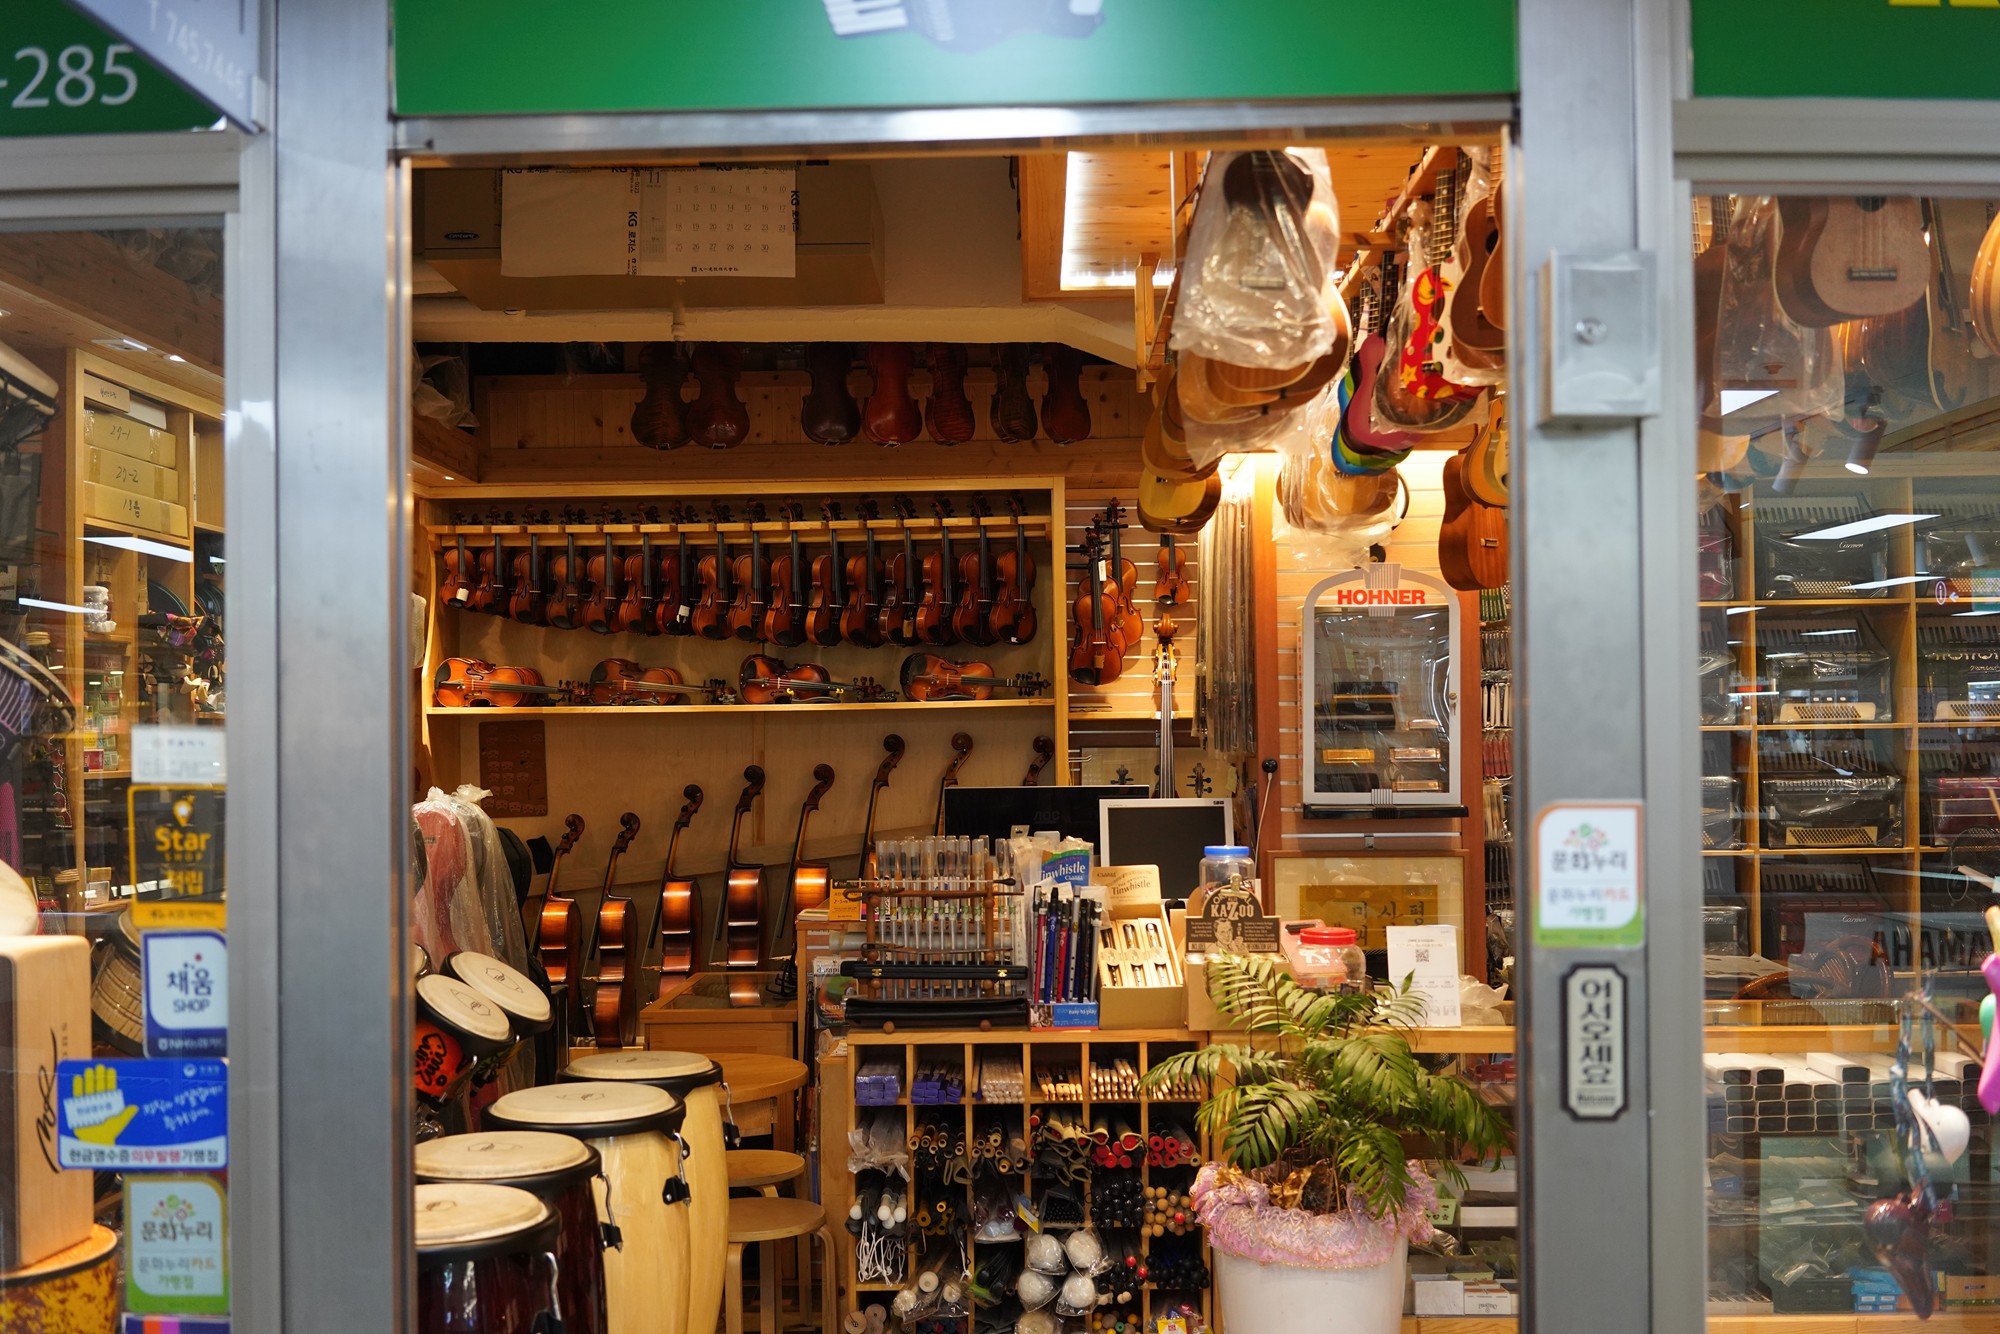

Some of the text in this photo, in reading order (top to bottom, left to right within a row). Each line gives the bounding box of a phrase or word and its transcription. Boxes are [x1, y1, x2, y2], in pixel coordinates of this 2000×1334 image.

[791, 190, 801, 206] KG
[628, 211, 638, 227] KG
[628, 231, 637, 253] 로지스
[1337, 589, 1426, 605] HOHNER
[1033, 810, 1061, 821] AOC
[154, 826, 211, 852] Star
[164, 852, 204, 862] SHOP
[1551, 849, 1628, 872] 문화누리
[1042, 861, 1086, 880] inwhistle
[1112, 880, 1151, 896] Tinwhistle
[1211, 902, 1254, 921] KAZOO
[167, 964, 214, 995] 채움
[173, 999, 210, 1013] SHOP
[1580, 978, 1612, 1085] 어서오세요
[141, 1219, 213, 1242] 문화누리
[138, 1256, 216, 1273] 문화누리카드
